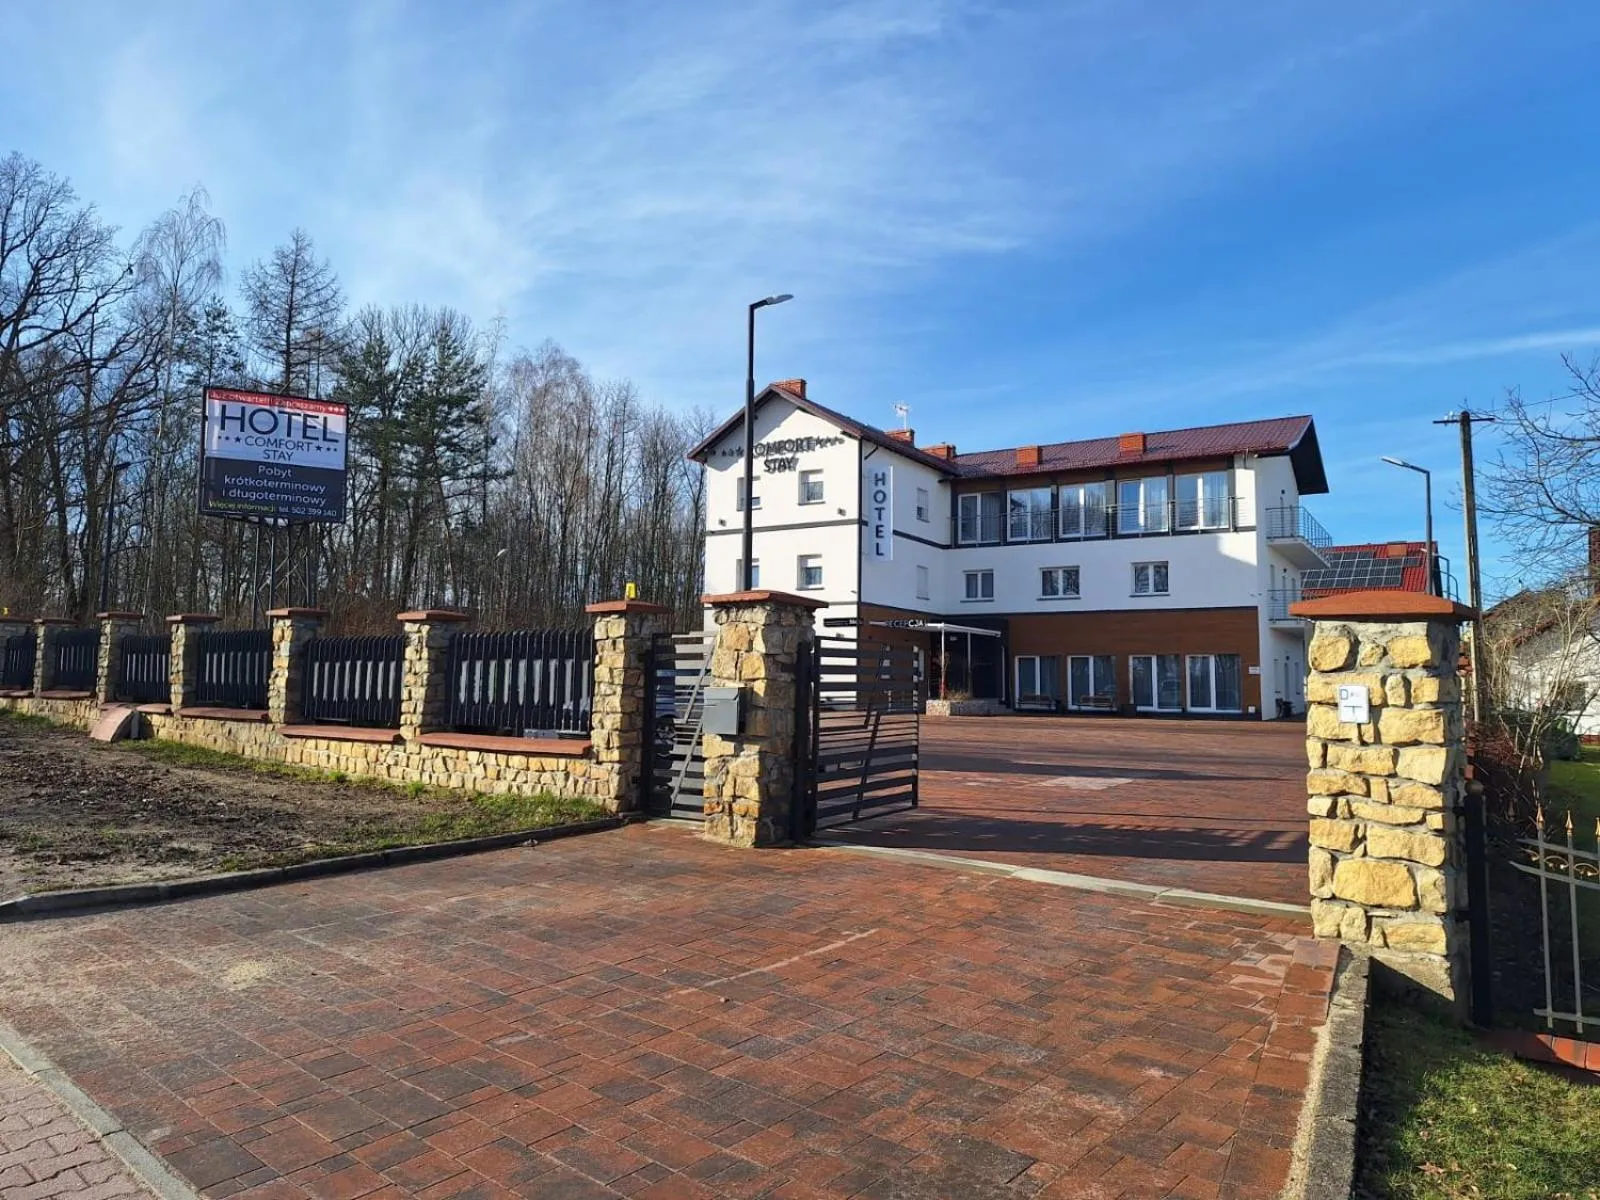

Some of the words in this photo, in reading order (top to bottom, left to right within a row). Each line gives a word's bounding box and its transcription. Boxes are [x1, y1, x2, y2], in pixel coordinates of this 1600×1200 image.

[220, 404, 339, 443] HOTEL
[244, 435, 313, 452] COMFORT
[752, 436, 816, 458] OMFORT
[263, 449, 294, 461] STAY
[258, 465, 292, 478] Pobyt
[764, 456, 797, 473] STAY
[224, 475, 326, 494] krótkoterminowy
[228, 488, 326, 506] długoterminowy
[873, 472, 887, 556] HOTEL
